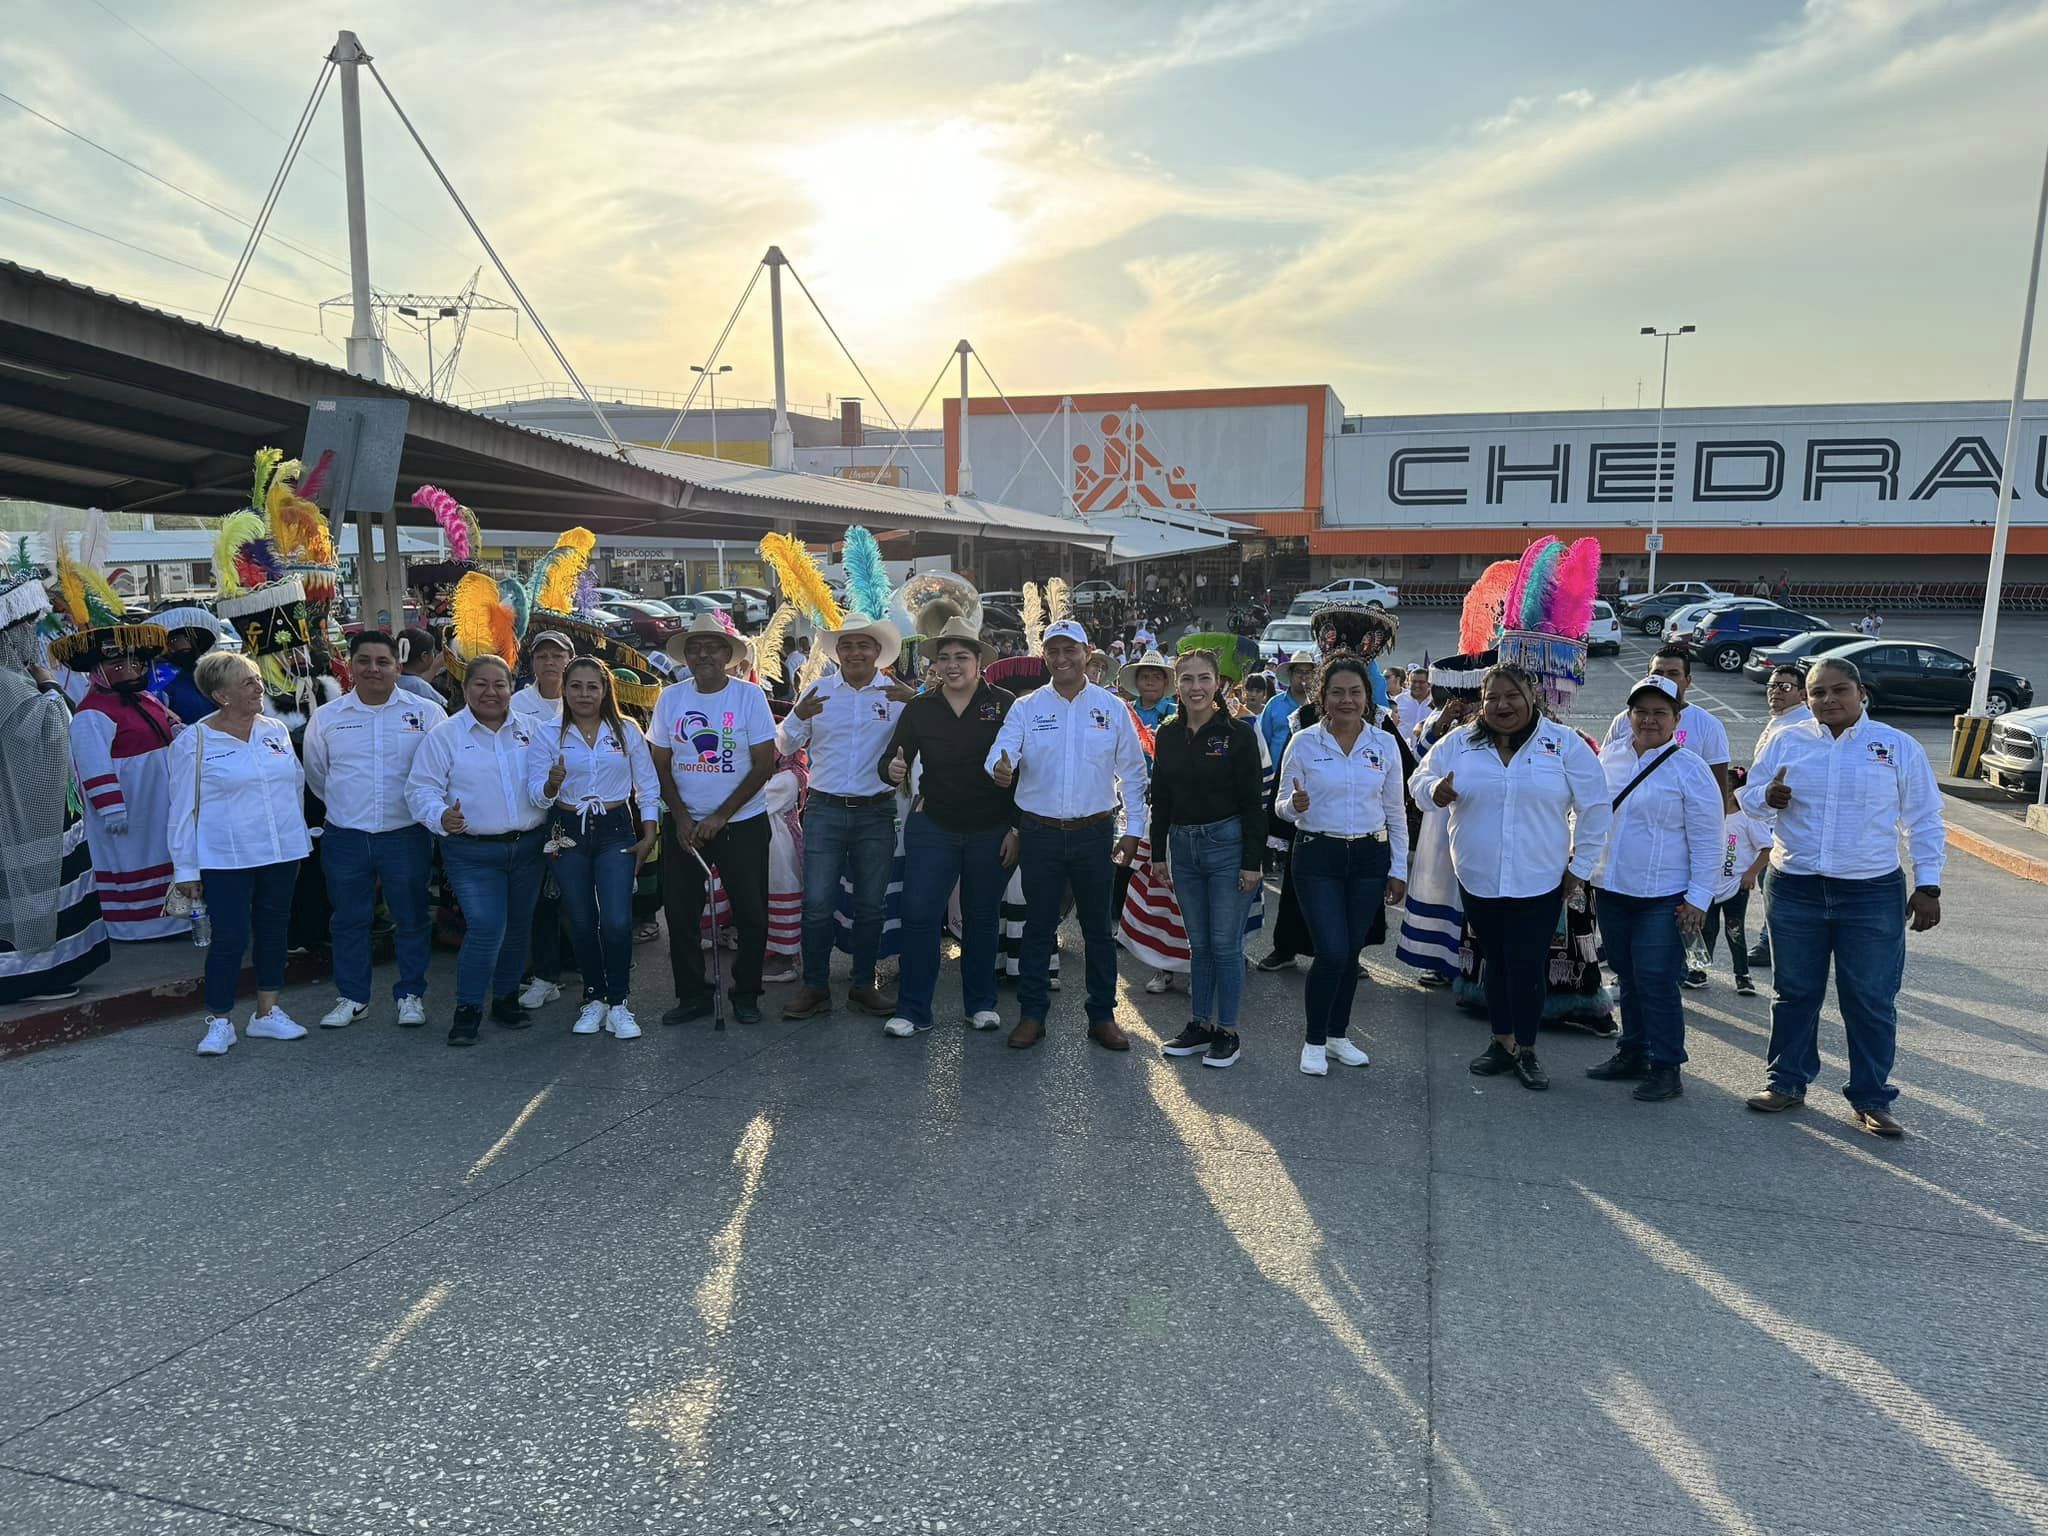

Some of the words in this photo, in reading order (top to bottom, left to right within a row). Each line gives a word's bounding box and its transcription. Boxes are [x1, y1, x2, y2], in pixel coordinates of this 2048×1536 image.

[1388, 434, 2048, 505] CHEDRA
[521, 547, 549, 559] Copp
[616, 548, 665, 560] BanCoppel
[721, 711, 737, 773] progresa
[678, 761, 720, 773] morelos
[1723, 832, 1737, 877] progresa
